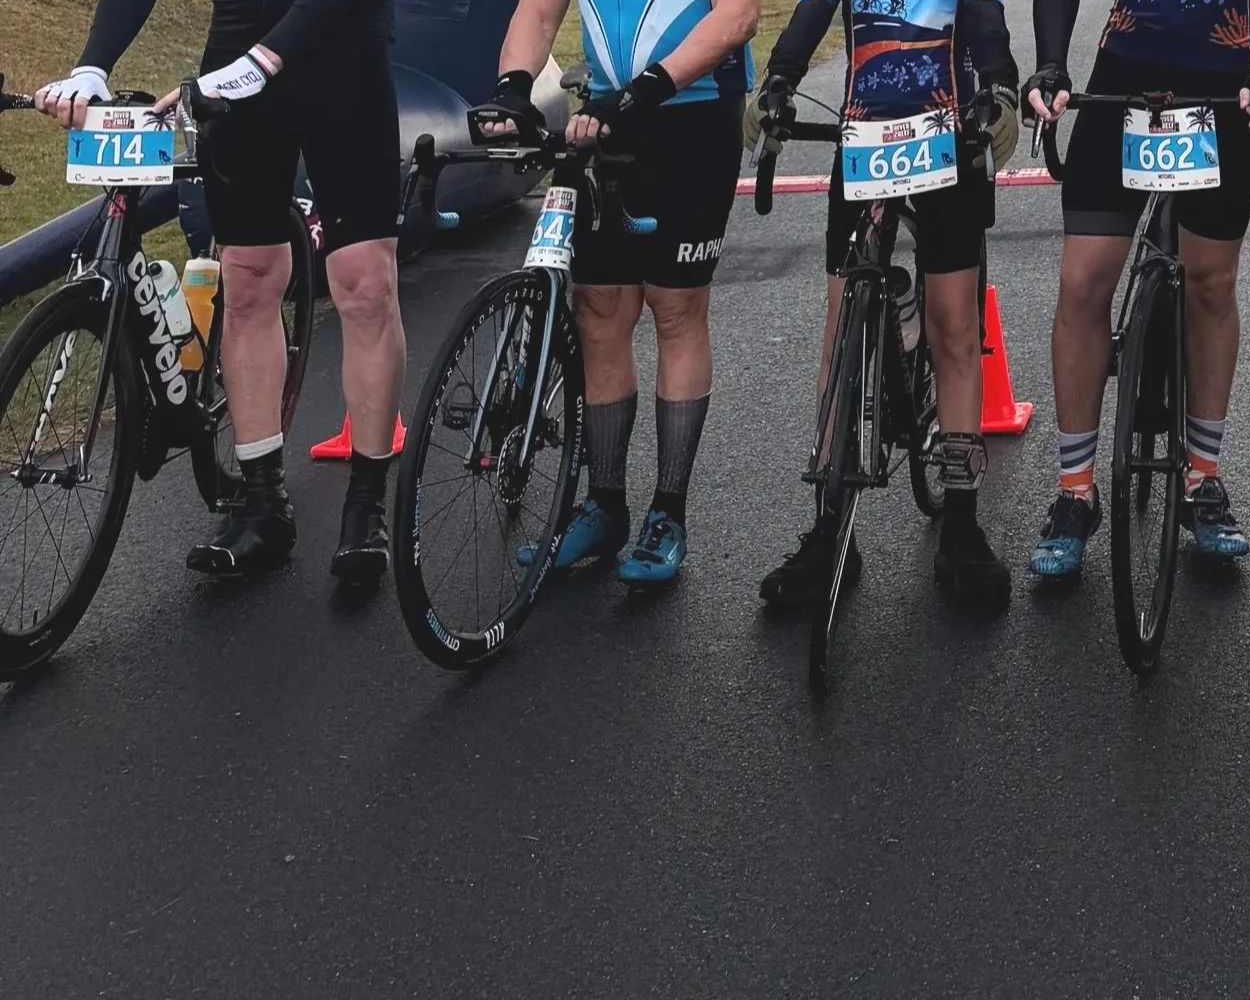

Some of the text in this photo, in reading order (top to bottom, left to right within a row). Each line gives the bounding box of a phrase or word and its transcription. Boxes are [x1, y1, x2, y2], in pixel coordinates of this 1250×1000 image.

[94, 133, 145, 165] 714
[869, 140, 933, 179] 664
[1139, 137, 1195, 170] 662
[532, 213, 575, 247] 642
[504, 287, 543, 303] CARBO
